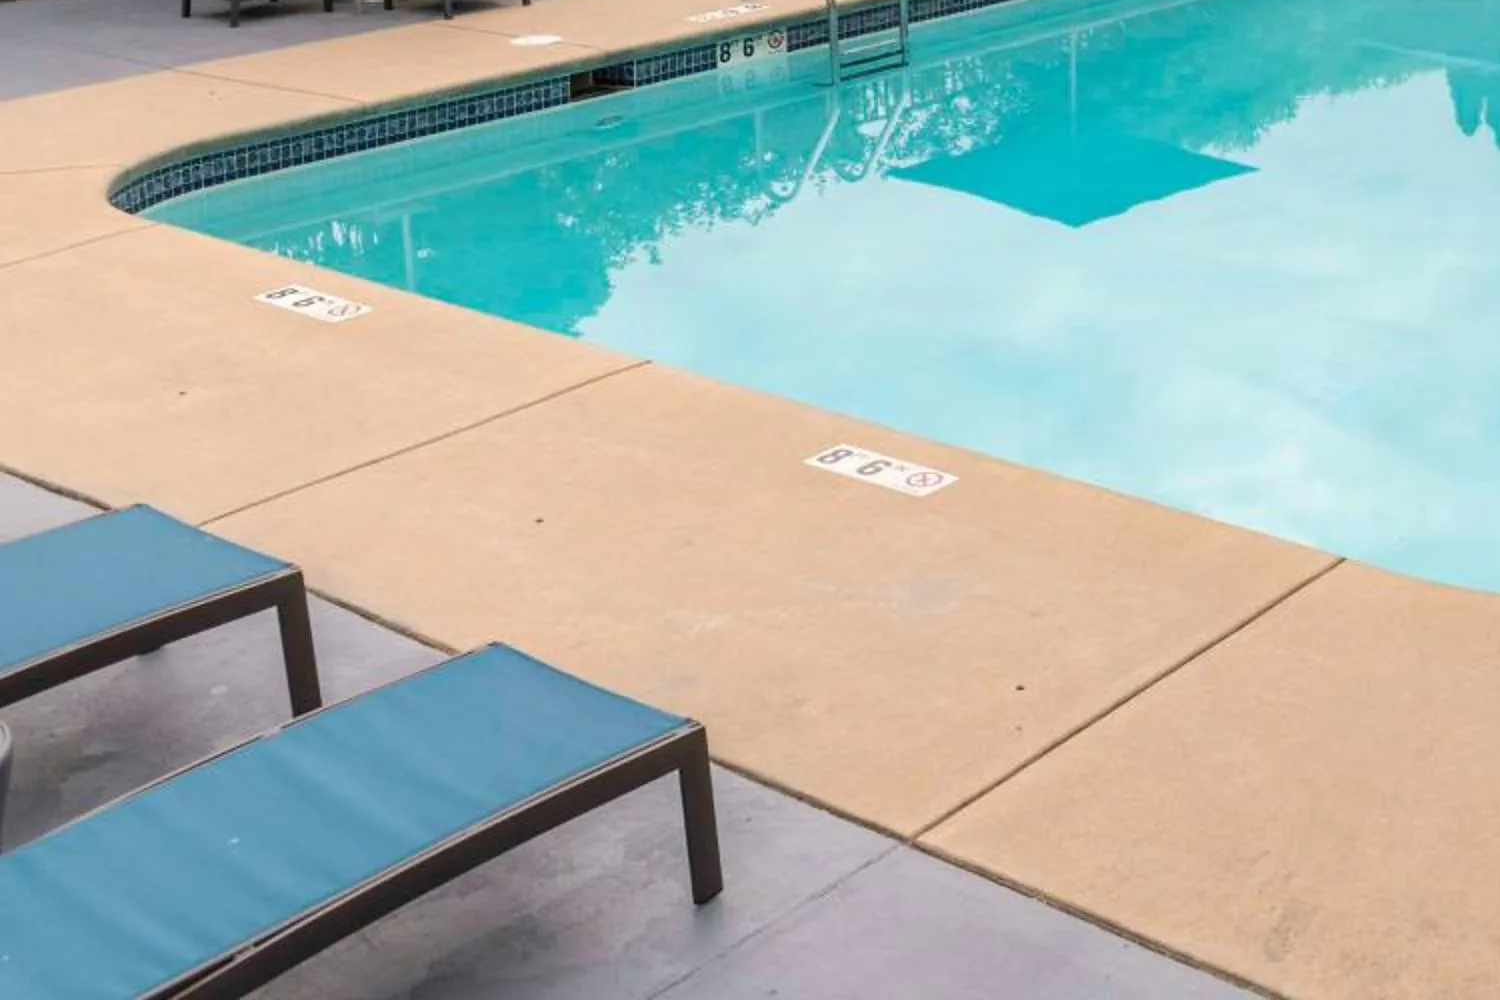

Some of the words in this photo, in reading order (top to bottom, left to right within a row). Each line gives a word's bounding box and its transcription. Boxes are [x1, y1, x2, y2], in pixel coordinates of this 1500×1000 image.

[719, 41, 731, 63] 8
[743, 37, 755, 57] 6
[264, 287, 298, 299] 8
[292, 295, 325, 307] 6
[816, 448, 853, 464] 8
[856, 459, 893, 476] 6
